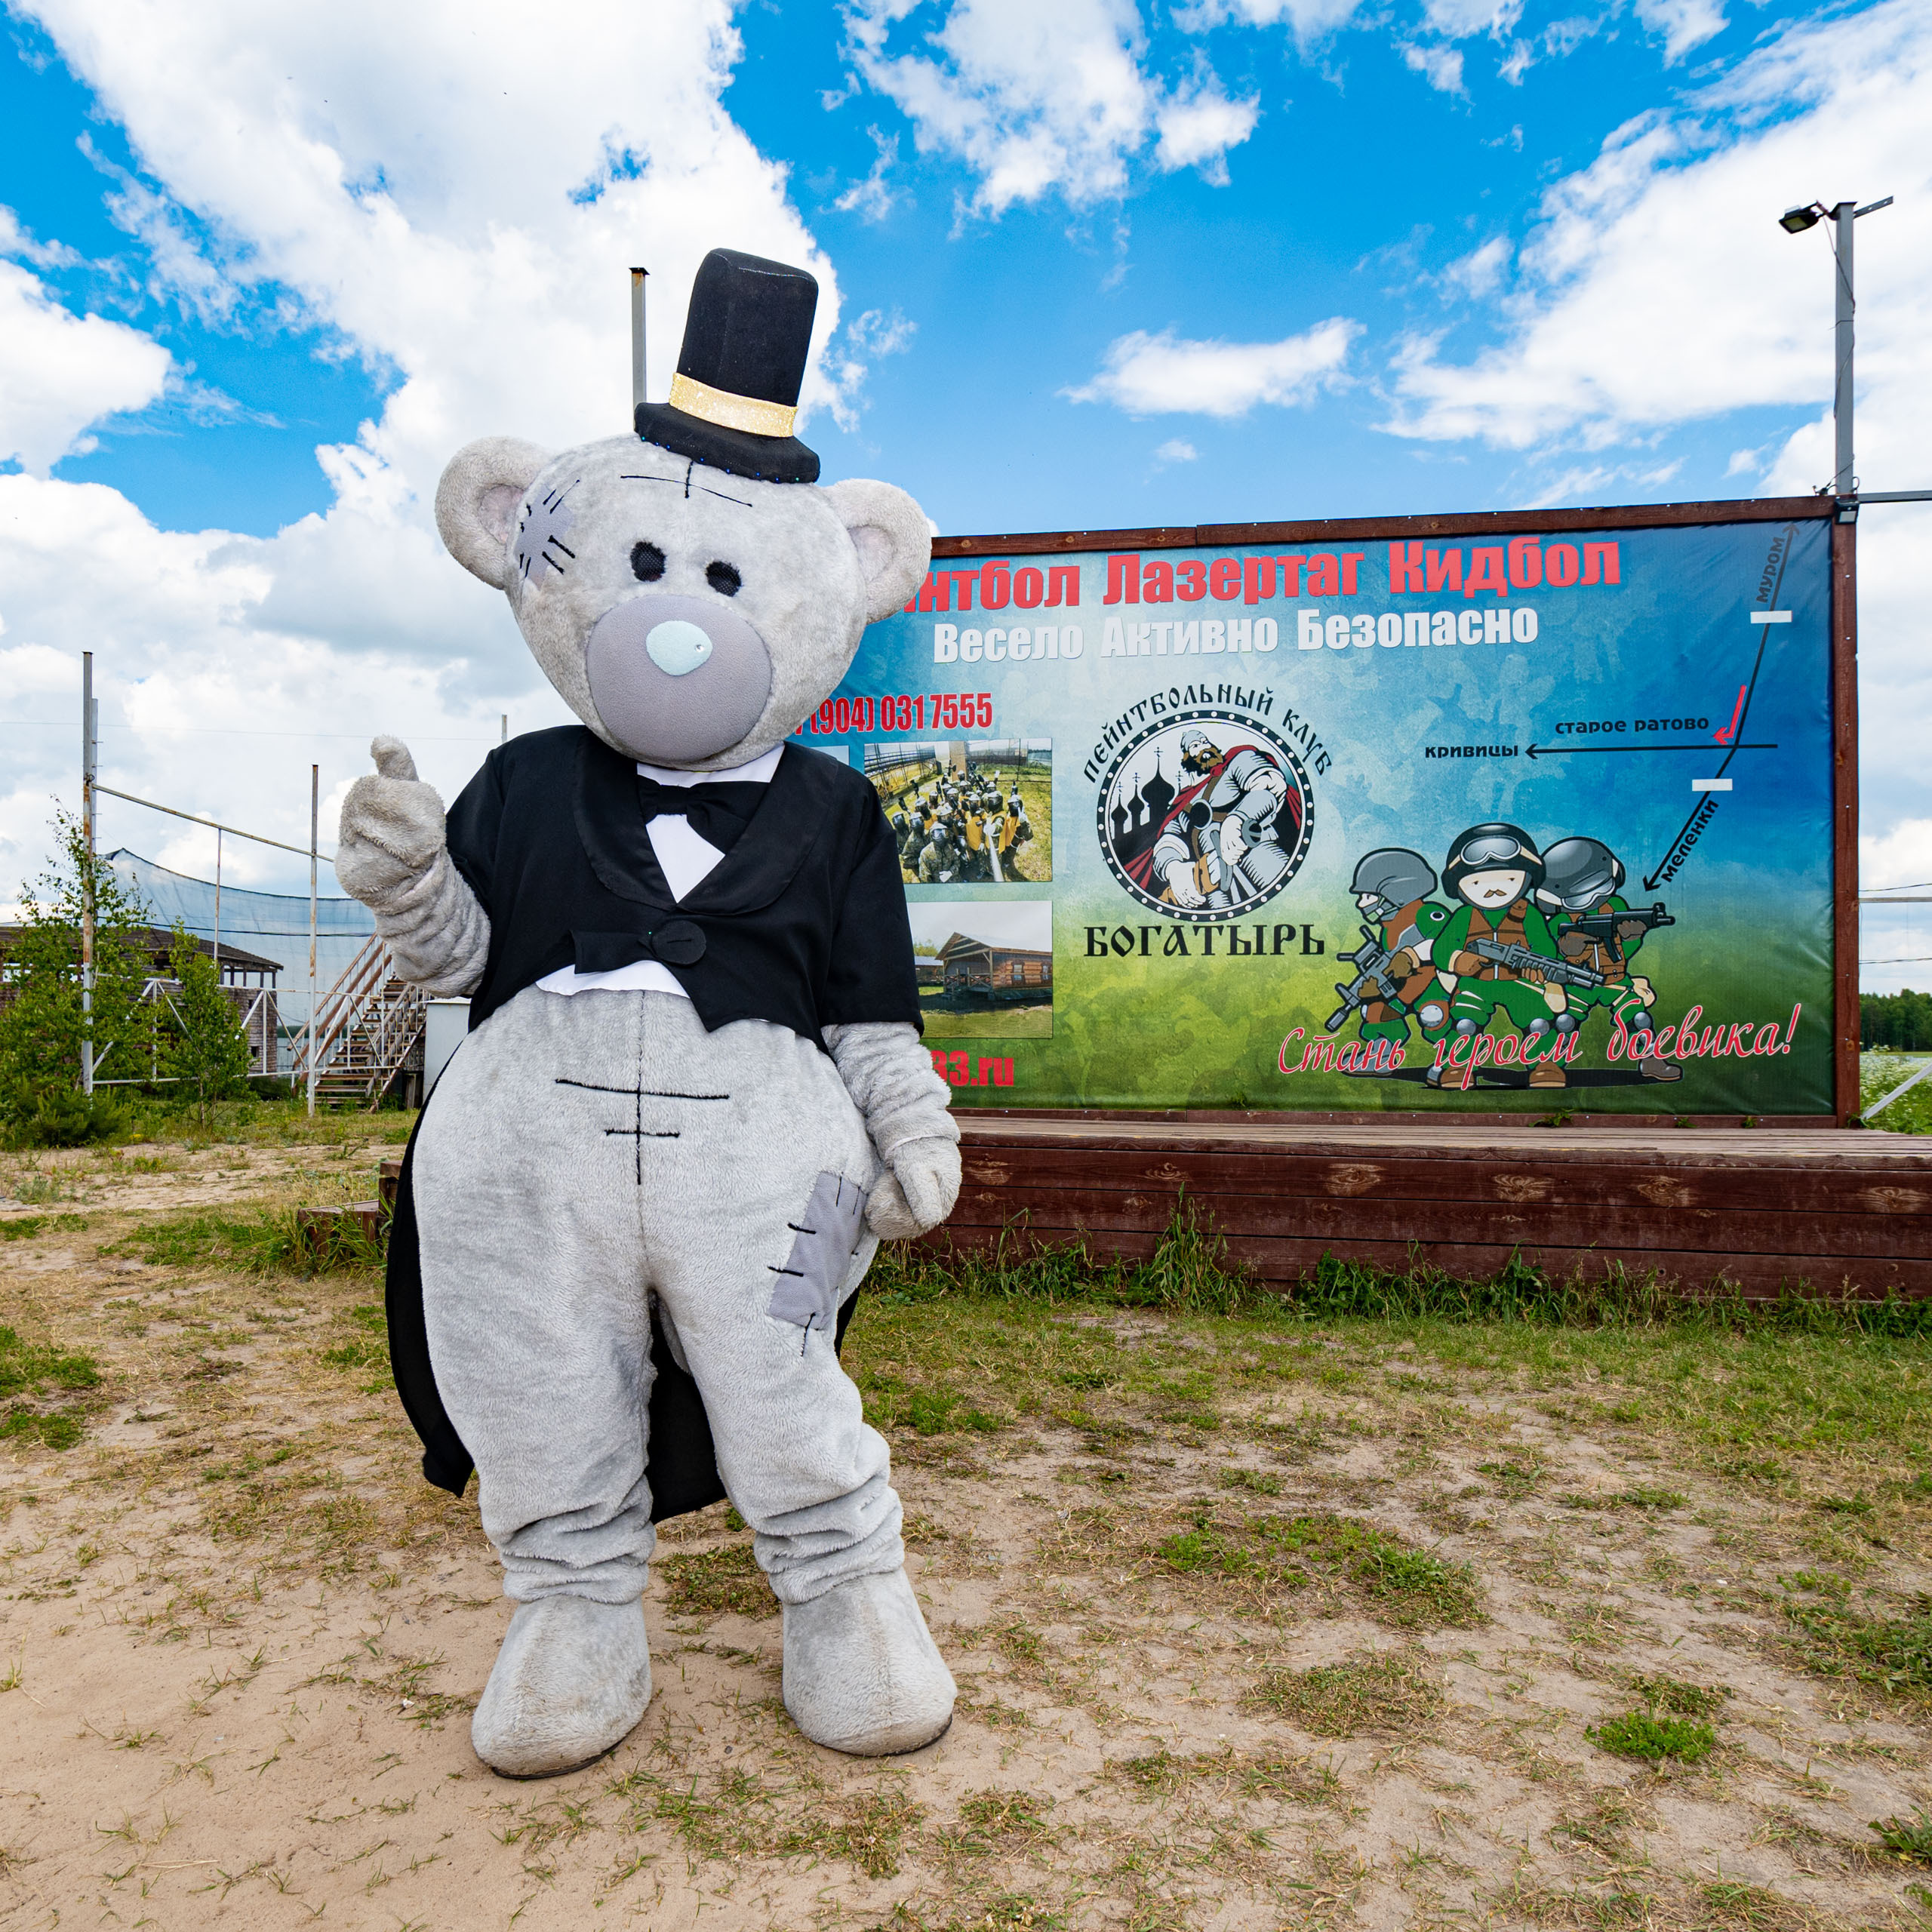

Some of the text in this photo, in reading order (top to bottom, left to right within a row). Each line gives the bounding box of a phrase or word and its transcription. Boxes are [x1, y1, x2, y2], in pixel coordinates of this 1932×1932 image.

[903, 537, 1621, 613] нтбол Лазертаг Кидбол
[934, 608, 1539, 663] Весело Активно Безопасно
[880, 694, 924, 732] 031
[929, 692, 993, 730] 7555
[1084, 683, 1333, 783] ПЕЙНТБОЛЬНЫЙ КЛУБ
[1083, 924, 1326, 958] БОГАТЫРЬ
[1278, 998, 1802, 1091] Стань героем боевика!
